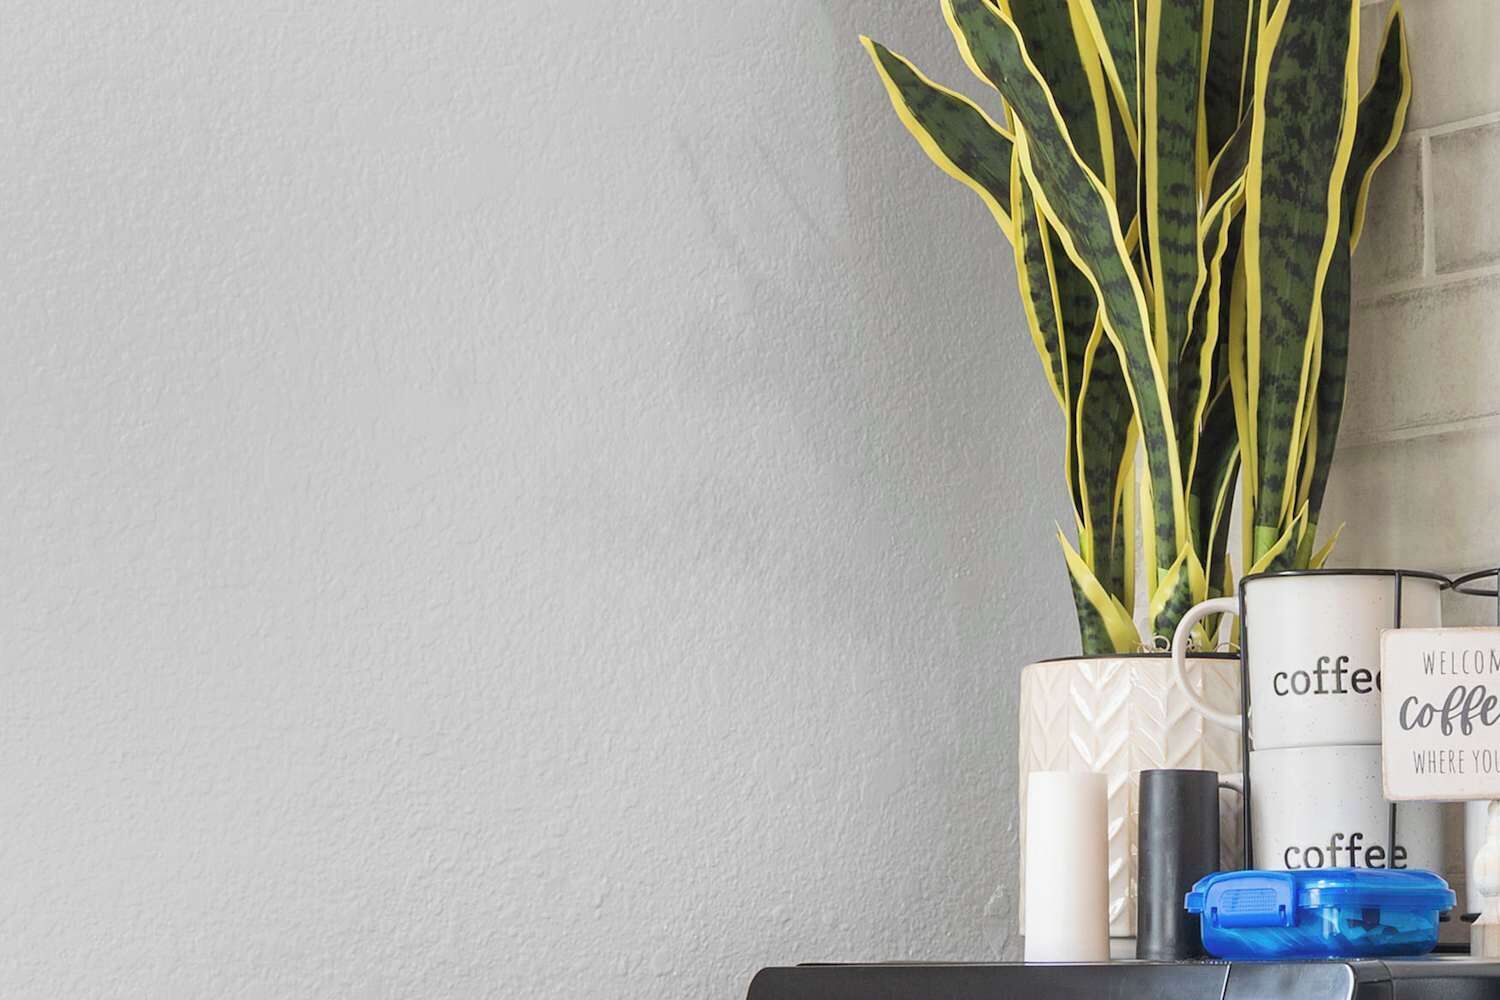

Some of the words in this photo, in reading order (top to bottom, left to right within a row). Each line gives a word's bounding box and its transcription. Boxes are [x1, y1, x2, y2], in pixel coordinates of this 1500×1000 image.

[1273, 655, 1381, 696] coffe
[1412, 749, 1465, 775] WHERE
[1284, 832, 1408, 869] coffee
